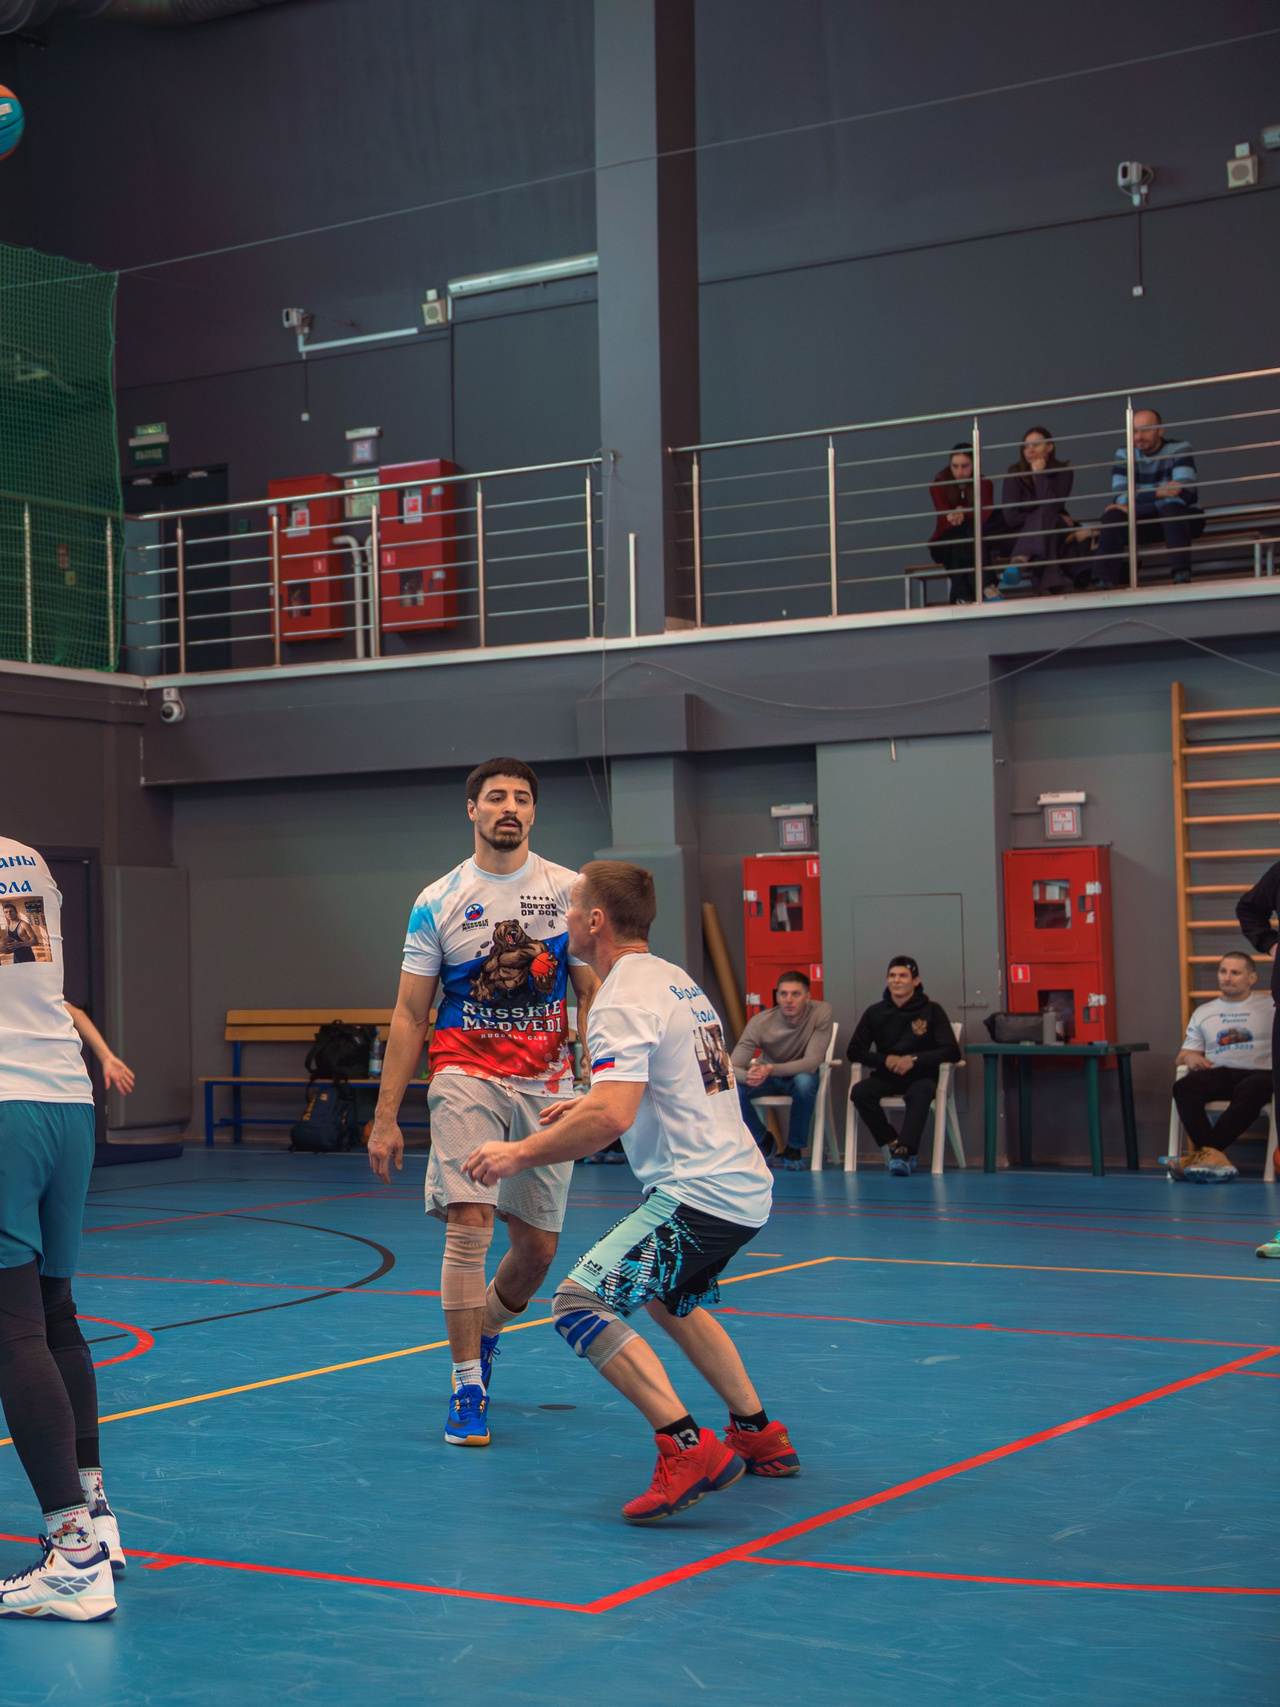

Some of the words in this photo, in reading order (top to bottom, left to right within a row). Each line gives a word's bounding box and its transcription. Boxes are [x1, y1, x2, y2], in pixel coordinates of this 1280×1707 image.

[520, 902, 557, 910] ROSTOV
[521, 909, 535, 917] ON
[538, 909, 558, 918] DON
[462, 1000, 562, 1019] RUSSKIE
[462, 1015, 562, 1034] MEDVEDI
